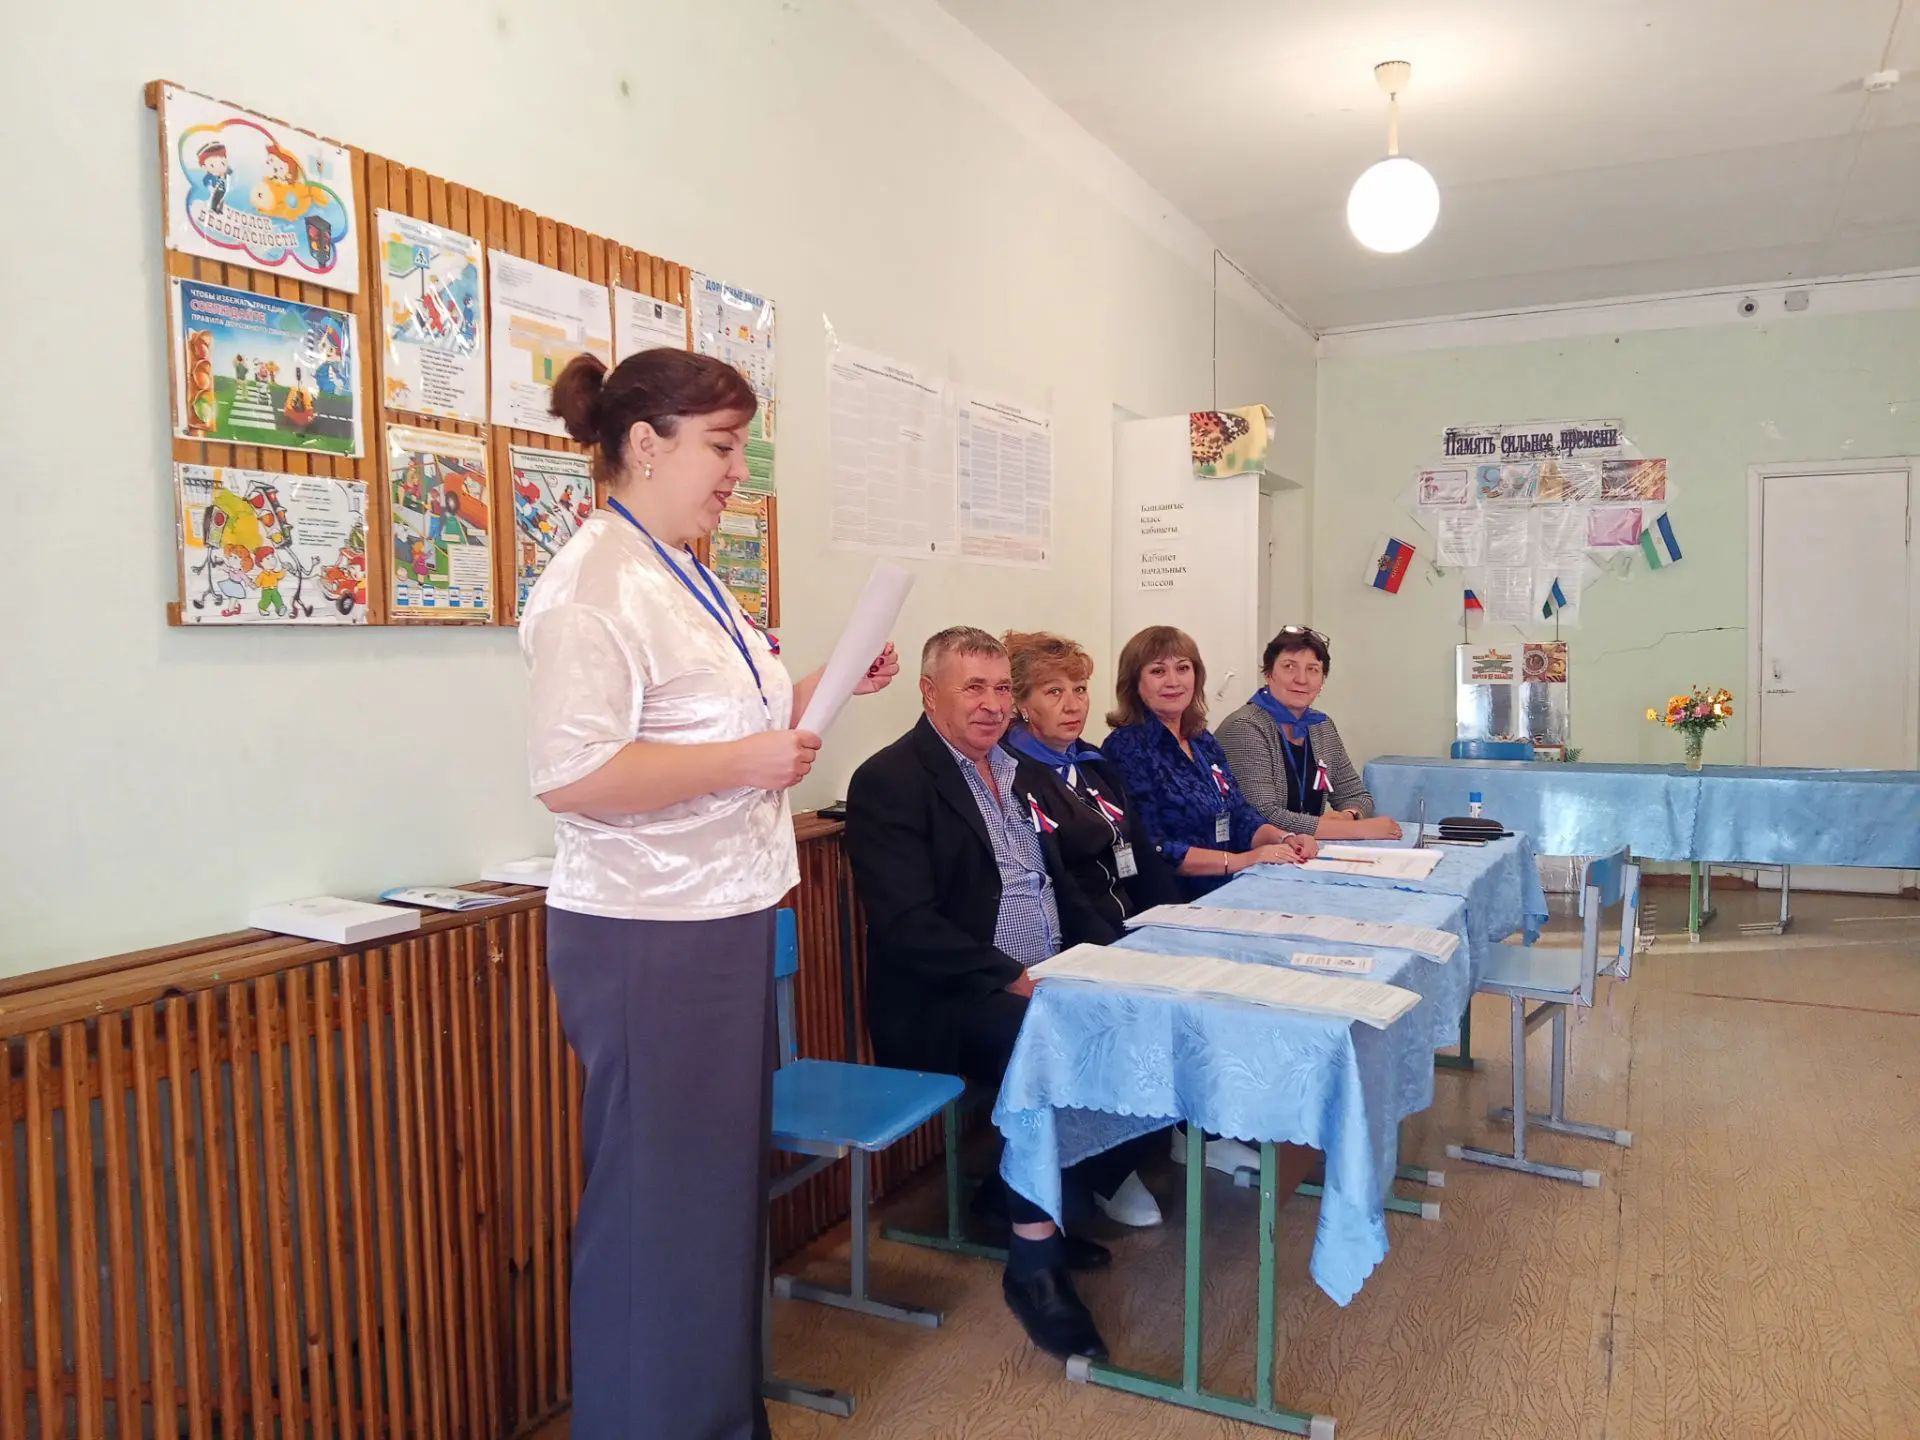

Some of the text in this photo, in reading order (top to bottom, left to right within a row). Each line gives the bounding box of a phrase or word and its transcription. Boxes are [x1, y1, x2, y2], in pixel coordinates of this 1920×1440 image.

[226, 208, 271, 231] УГОЛОК
[198, 210, 297, 246] БЕЗОПАСНОСТИ
[190, 289, 215, 300] ЧТОБЫ
[190, 299, 267, 325] СОБЛЮДАЙТЕ
[191, 313, 224, 326] ПРАВИЛА
[1445, 428, 1618, 457] Память сильнее времени
[1141, 553, 1177, 563] Кабинет
[1141, 566, 1187, 575] начальных
[1141, 579, 1174, 587] классов
